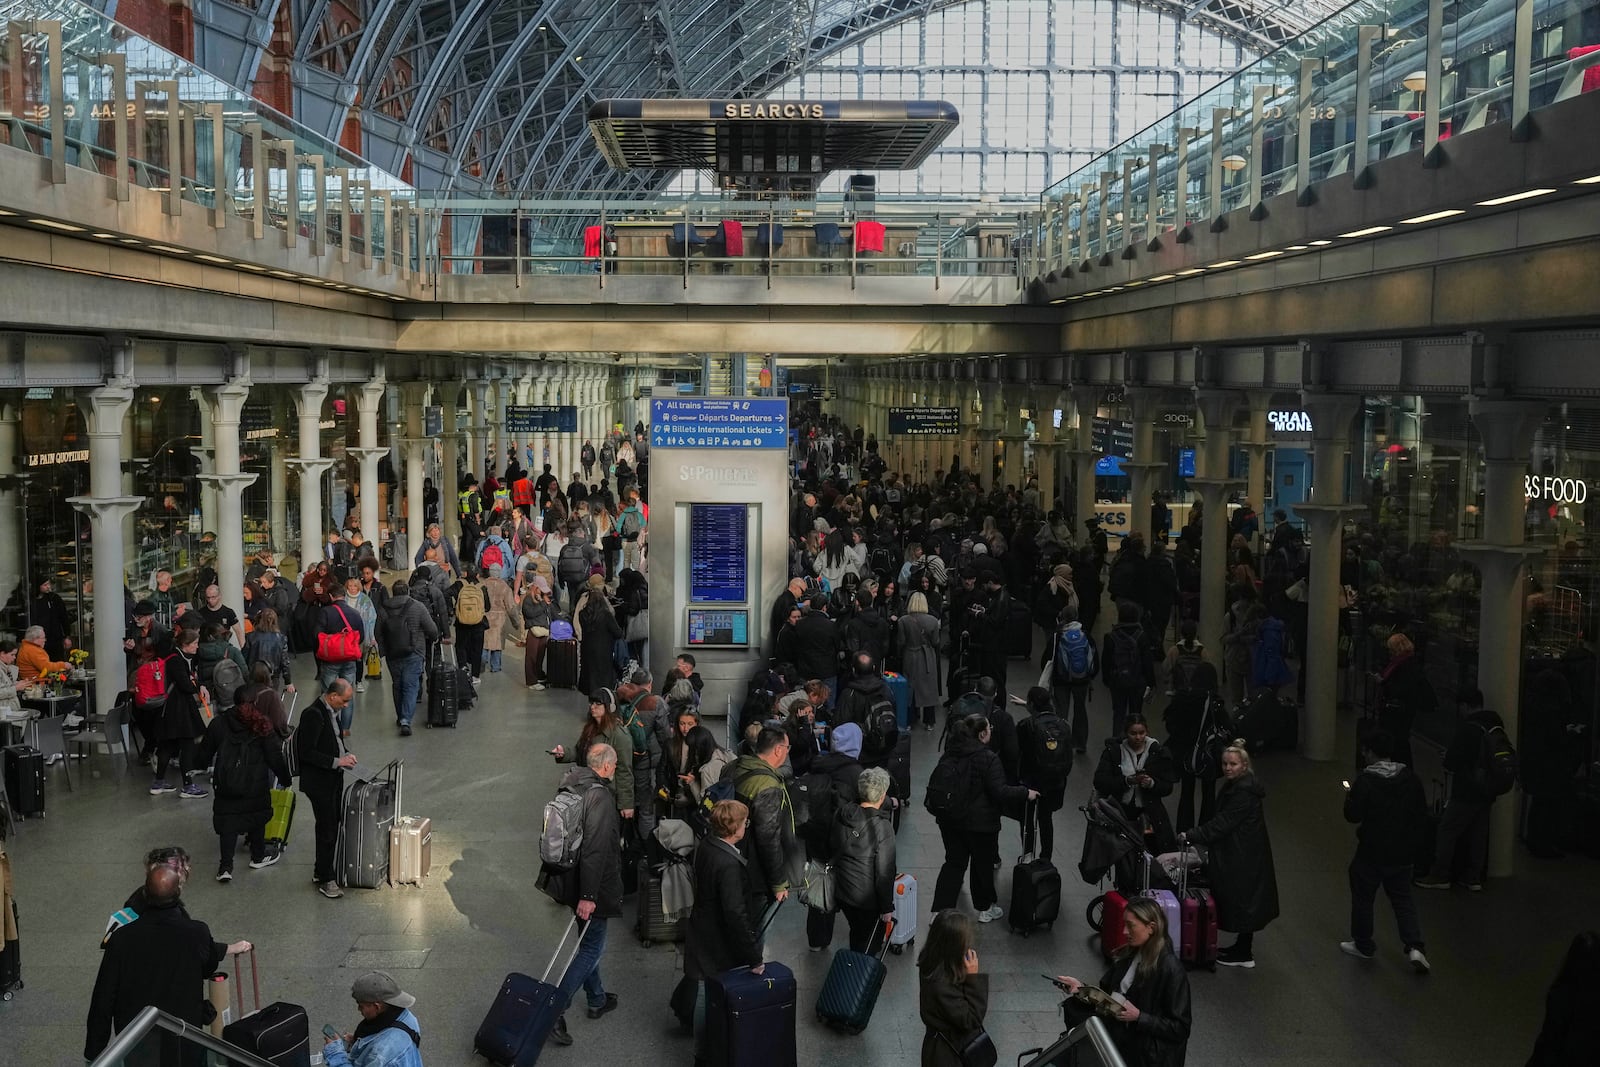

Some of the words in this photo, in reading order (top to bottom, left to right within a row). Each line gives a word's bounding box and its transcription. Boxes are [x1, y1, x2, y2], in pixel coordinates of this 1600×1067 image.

[725, 103, 824, 118] SEARCYS
[667, 401, 678, 409] All
[699, 413, 728, 423] Départs
[730, 414, 772, 423] Departures
[672, 425, 696, 433] Billets
[698, 425, 745, 433] International
[748, 425, 772, 434] tickets
[29, 454, 39, 466] LE
[39, 453, 56, 465] PAIN
[1544, 476, 1587, 504] FOOD
